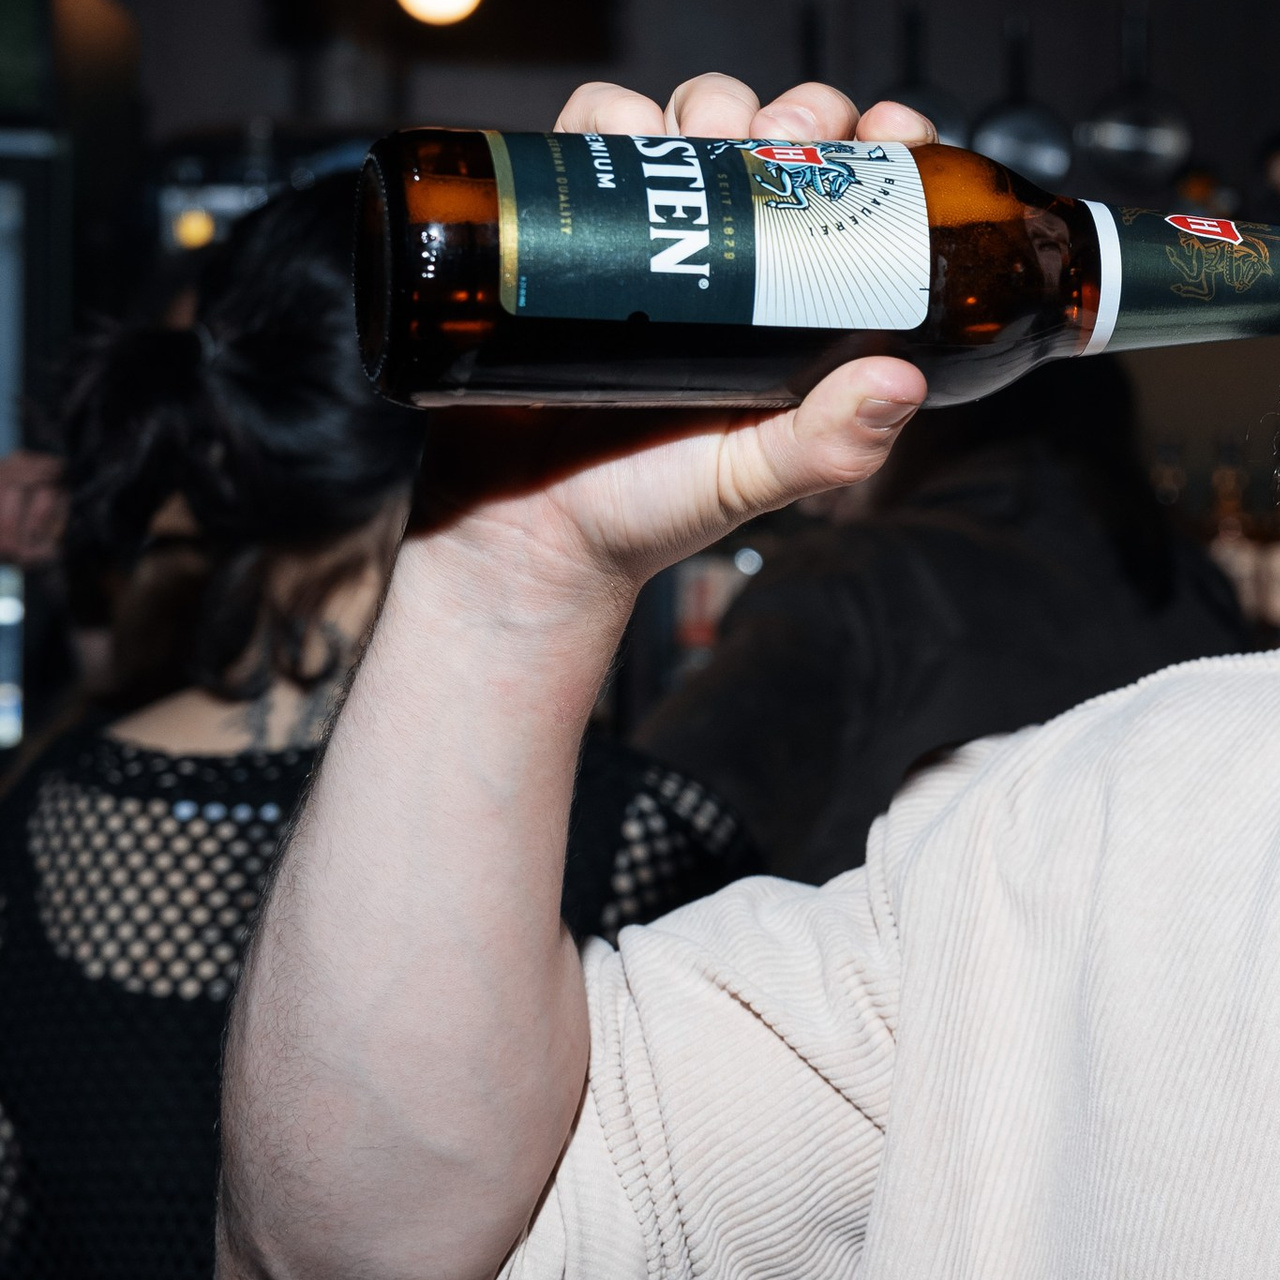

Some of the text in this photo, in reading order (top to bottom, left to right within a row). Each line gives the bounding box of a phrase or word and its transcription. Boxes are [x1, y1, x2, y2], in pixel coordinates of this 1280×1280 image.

[772, 149, 806, 160] H
[717, 173, 732, 205] SEIT
[556, 176, 573, 235] QUALITY
[809, 178, 895, 237] BRAUEREI
[1186, 218, 1221, 233] H
